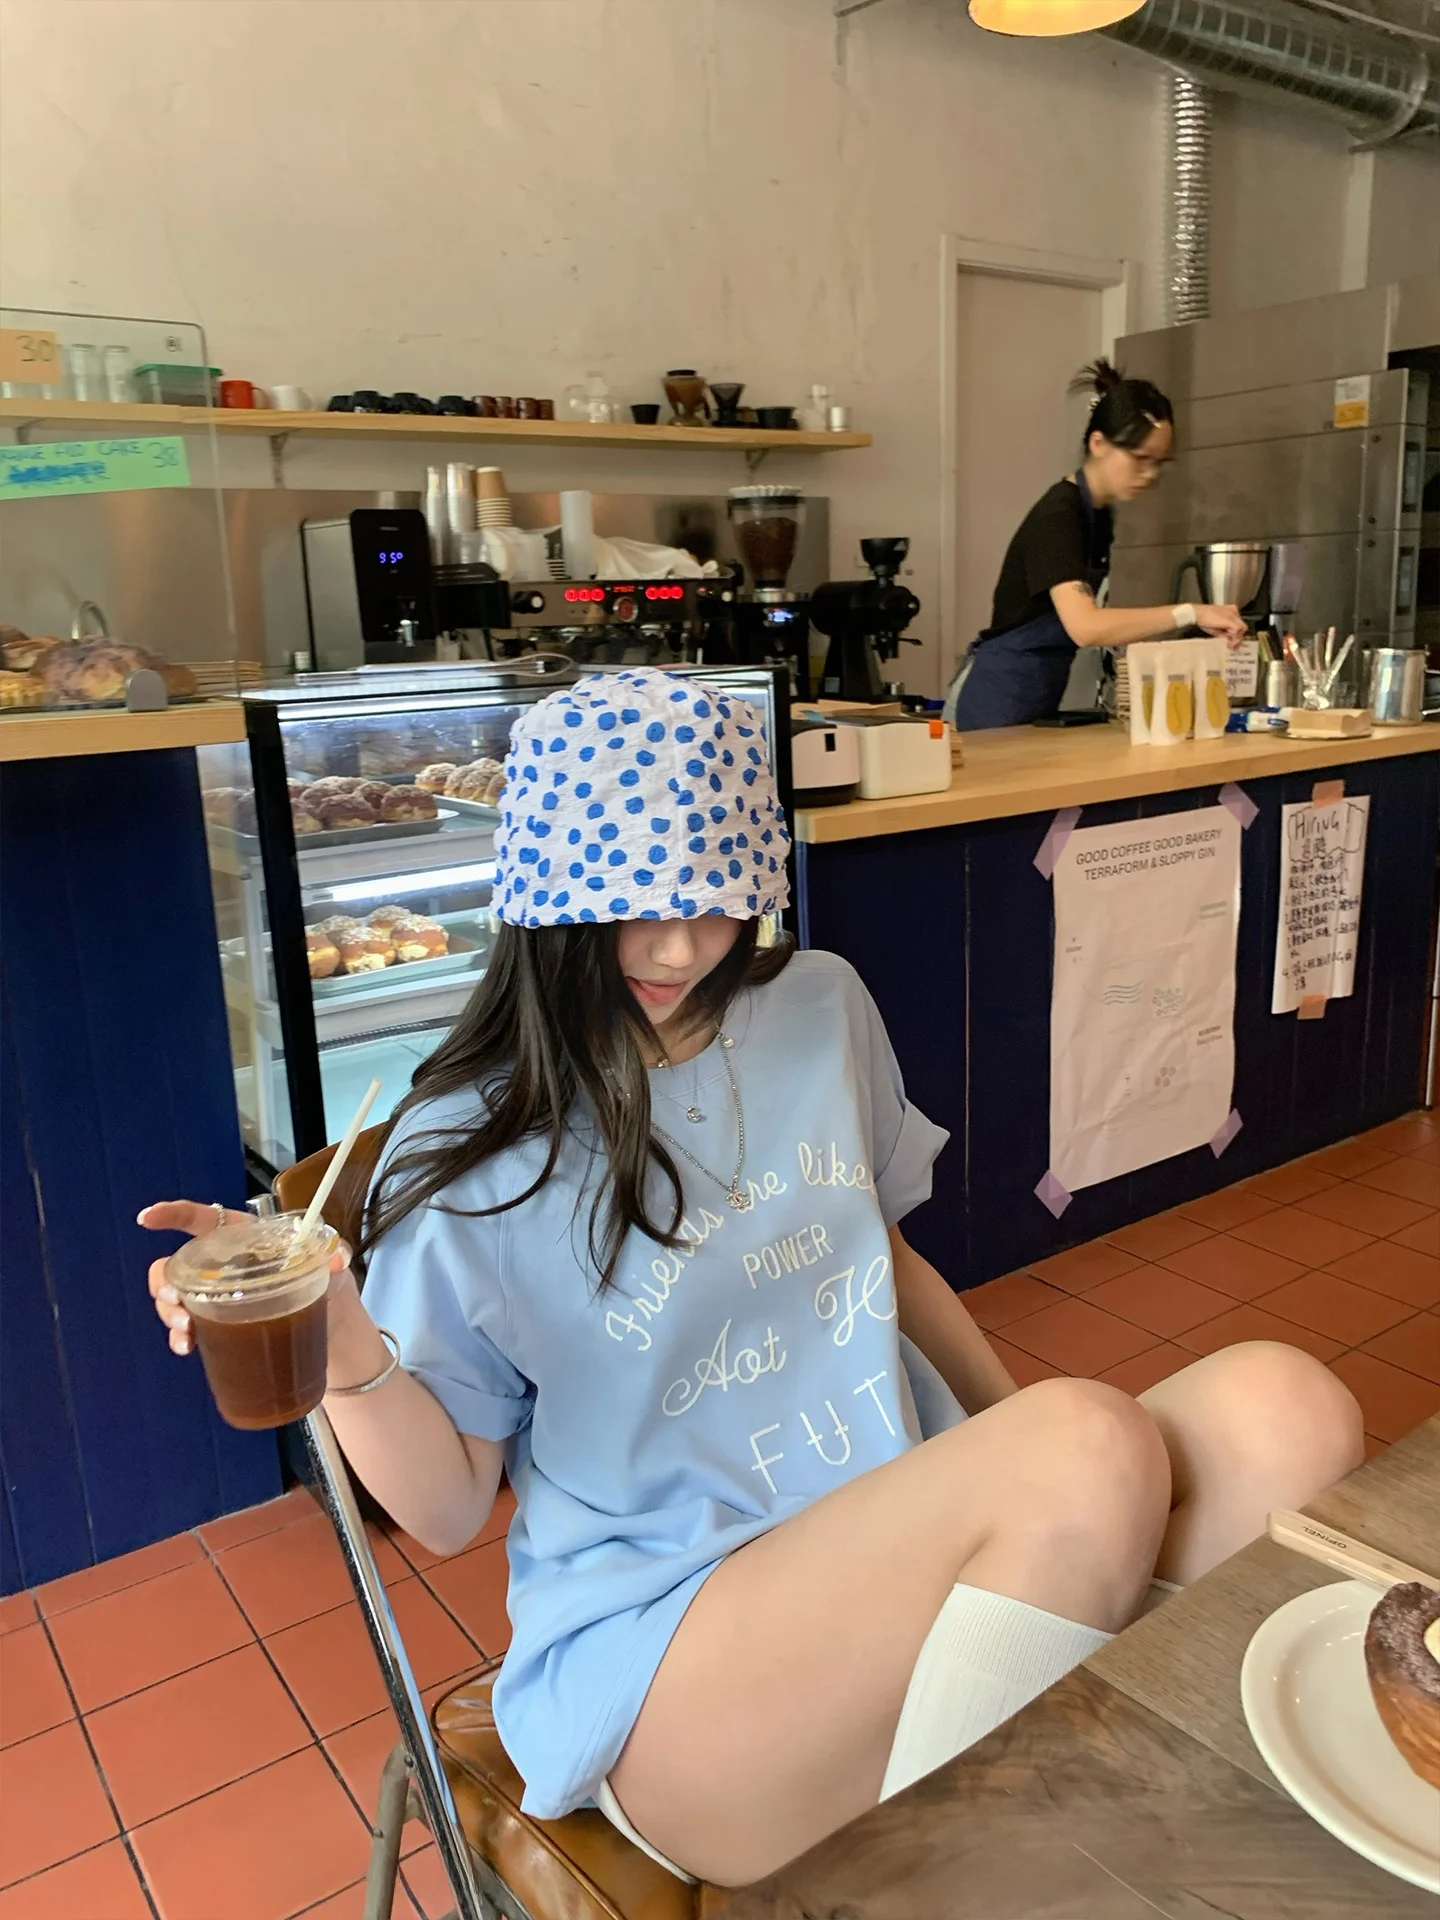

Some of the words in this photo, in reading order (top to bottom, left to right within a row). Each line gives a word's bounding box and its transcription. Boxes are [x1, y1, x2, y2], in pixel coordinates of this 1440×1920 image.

[15, 333, 54, 363] 30
[1076, 849, 1108, 865] GOOD
[1111, 841, 1151, 859] COFFEE
[1153, 835, 1183, 851] GOOD
[1185, 828, 1224, 845] BAKERY
[1084, 860, 1149, 881] TERRAFORM
[1150, 858, 1157, 869] &
[1158, 850, 1196, 867] SLOPPY
[1197, 847, 1216, 860] GIN
[797, 1141, 878, 1195] like
[742, 1223, 834, 1290] POWER
[1302, 1526, 1347, 1549] OPINEL
